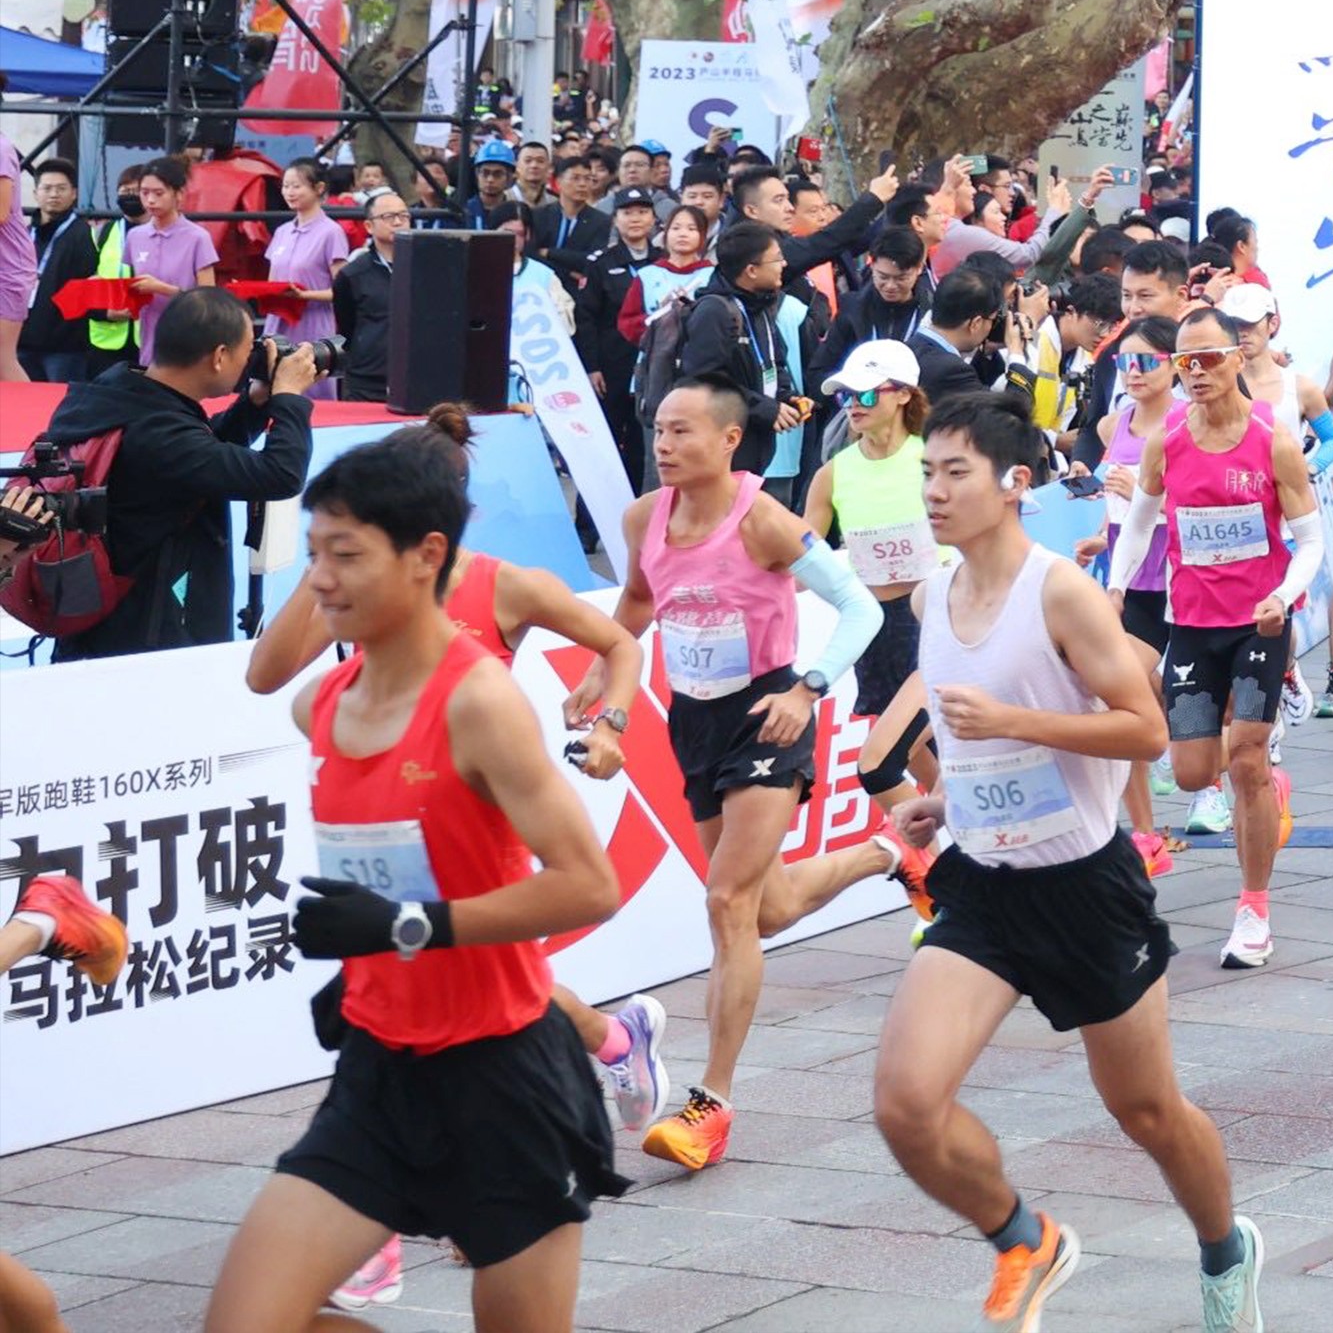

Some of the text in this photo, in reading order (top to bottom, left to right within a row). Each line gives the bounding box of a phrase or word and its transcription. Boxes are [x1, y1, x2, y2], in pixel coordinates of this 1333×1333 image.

[649, 66, 696, 80] 2023
[1189, 521, 1253, 541] A1645
[872, 538, 913, 560] S28
[680, 645, 715, 668] S07
[973, 779, 1025, 811] S06
[340, 857, 393, 890] S18
